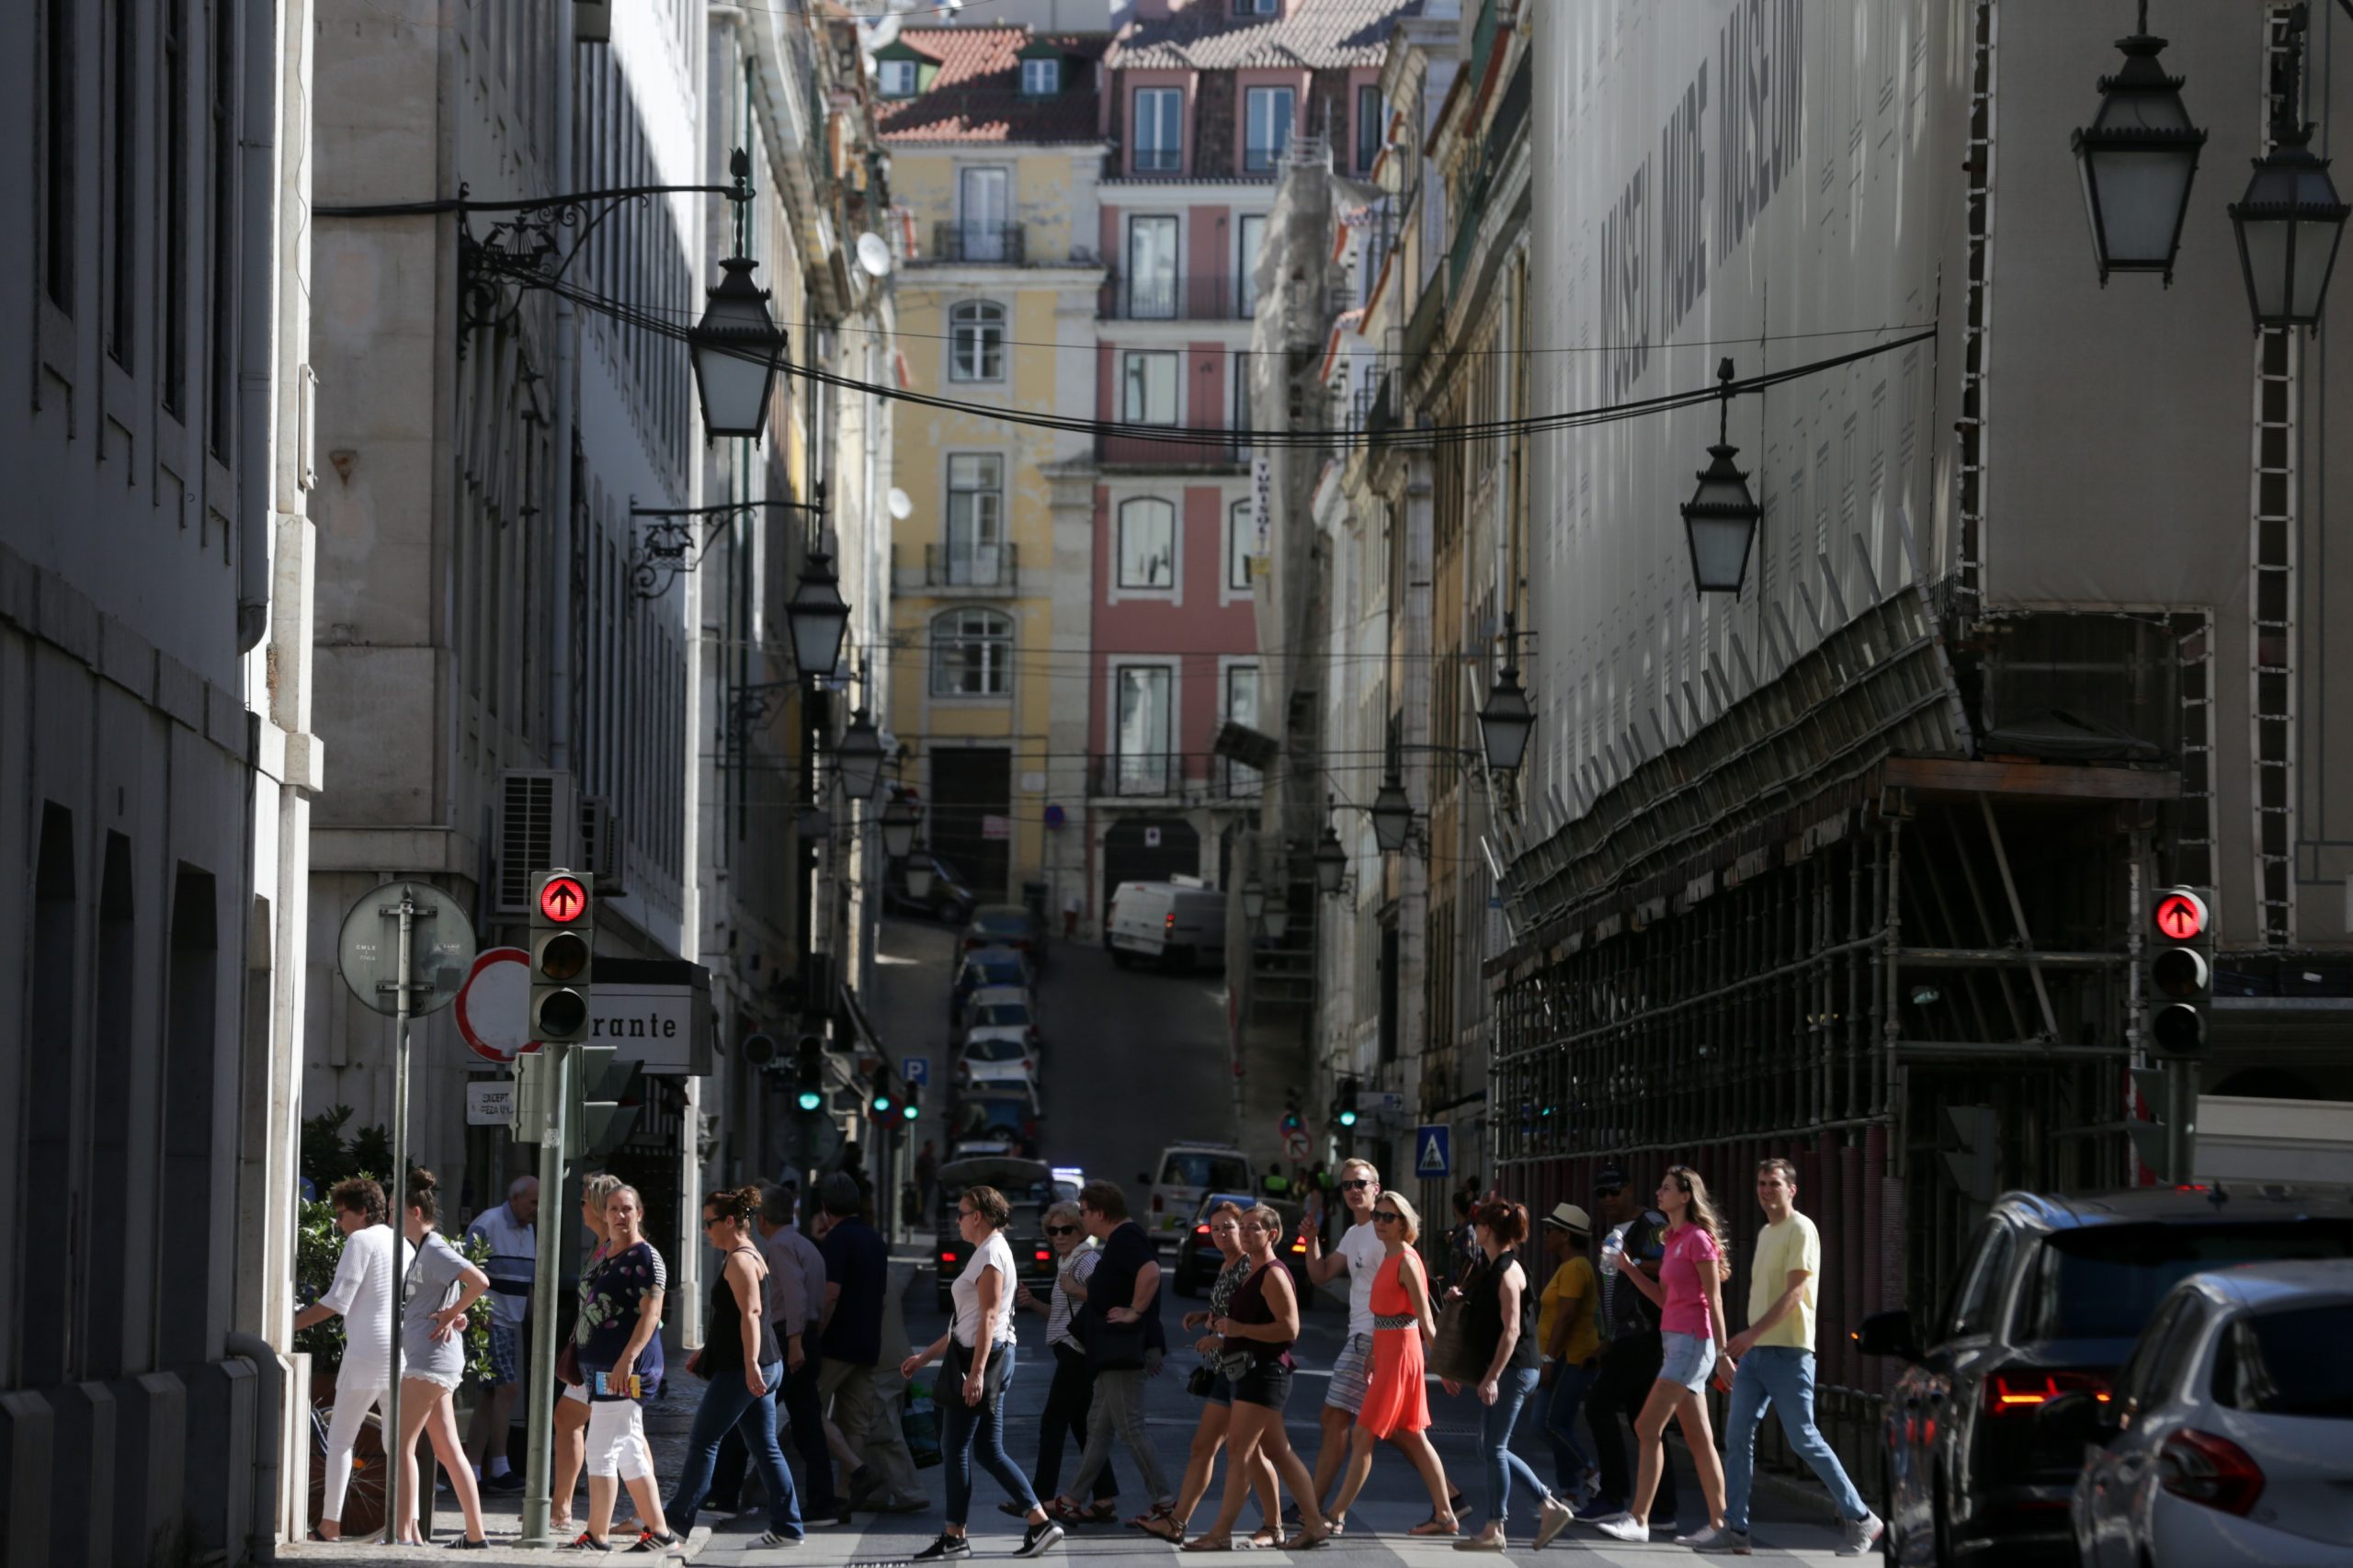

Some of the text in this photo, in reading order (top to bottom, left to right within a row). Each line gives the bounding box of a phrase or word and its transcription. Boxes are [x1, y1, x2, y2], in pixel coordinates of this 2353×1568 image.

[1600, 0, 1803, 420] MUSEU MUDE MUSEUM
[907, 1061, 924, 1081] P
